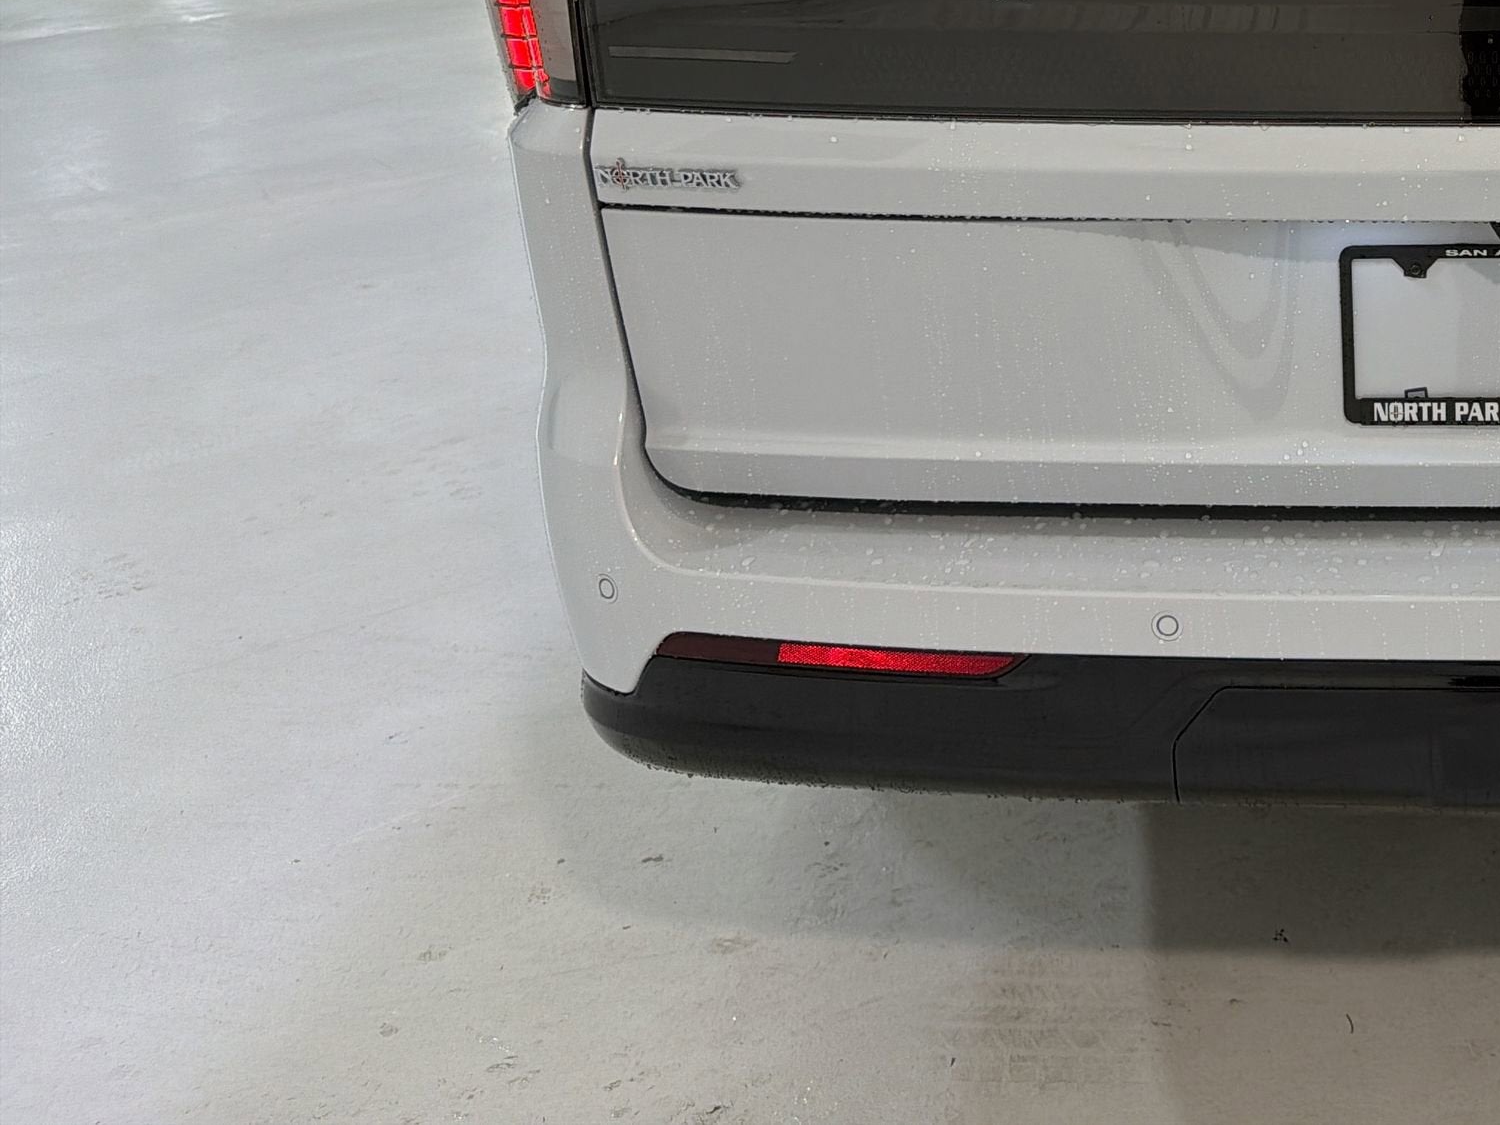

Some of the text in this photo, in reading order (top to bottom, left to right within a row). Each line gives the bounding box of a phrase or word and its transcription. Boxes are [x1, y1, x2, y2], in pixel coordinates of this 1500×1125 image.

[594, 166, 738, 189] NORTH PARK
[1444, 248, 1488, 258] SAN
[1373, 401, 1447, 423] NORTH
